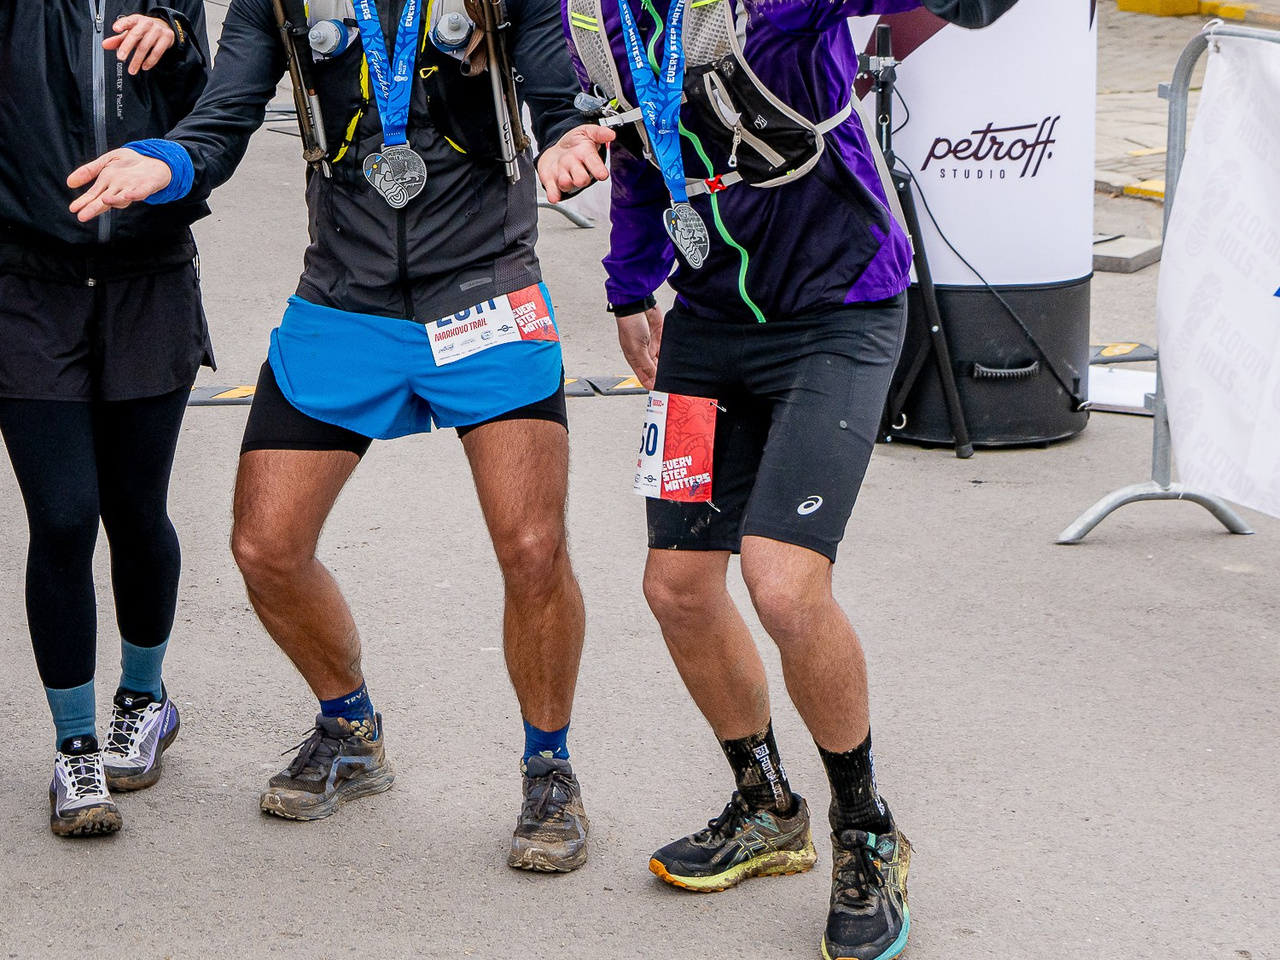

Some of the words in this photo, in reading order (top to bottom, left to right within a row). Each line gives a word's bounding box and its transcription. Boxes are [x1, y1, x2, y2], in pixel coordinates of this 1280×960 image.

[628, 26, 644, 70] MATTERS
[670, 27, 678, 51] STEP
[666, 52, 679, 84] EVERY
[939, 168, 1006, 179] STUDIO
[513, 300, 538, 317] EVERY
[515, 311, 537, 327] STEP
[434, 326, 469, 343] MARKOVO
[468, 317, 489, 331] TRAIL
[662, 454, 693, 472] EVERY
[661, 467, 688, 481] STEP
[663, 472, 712, 492] MATTERS
